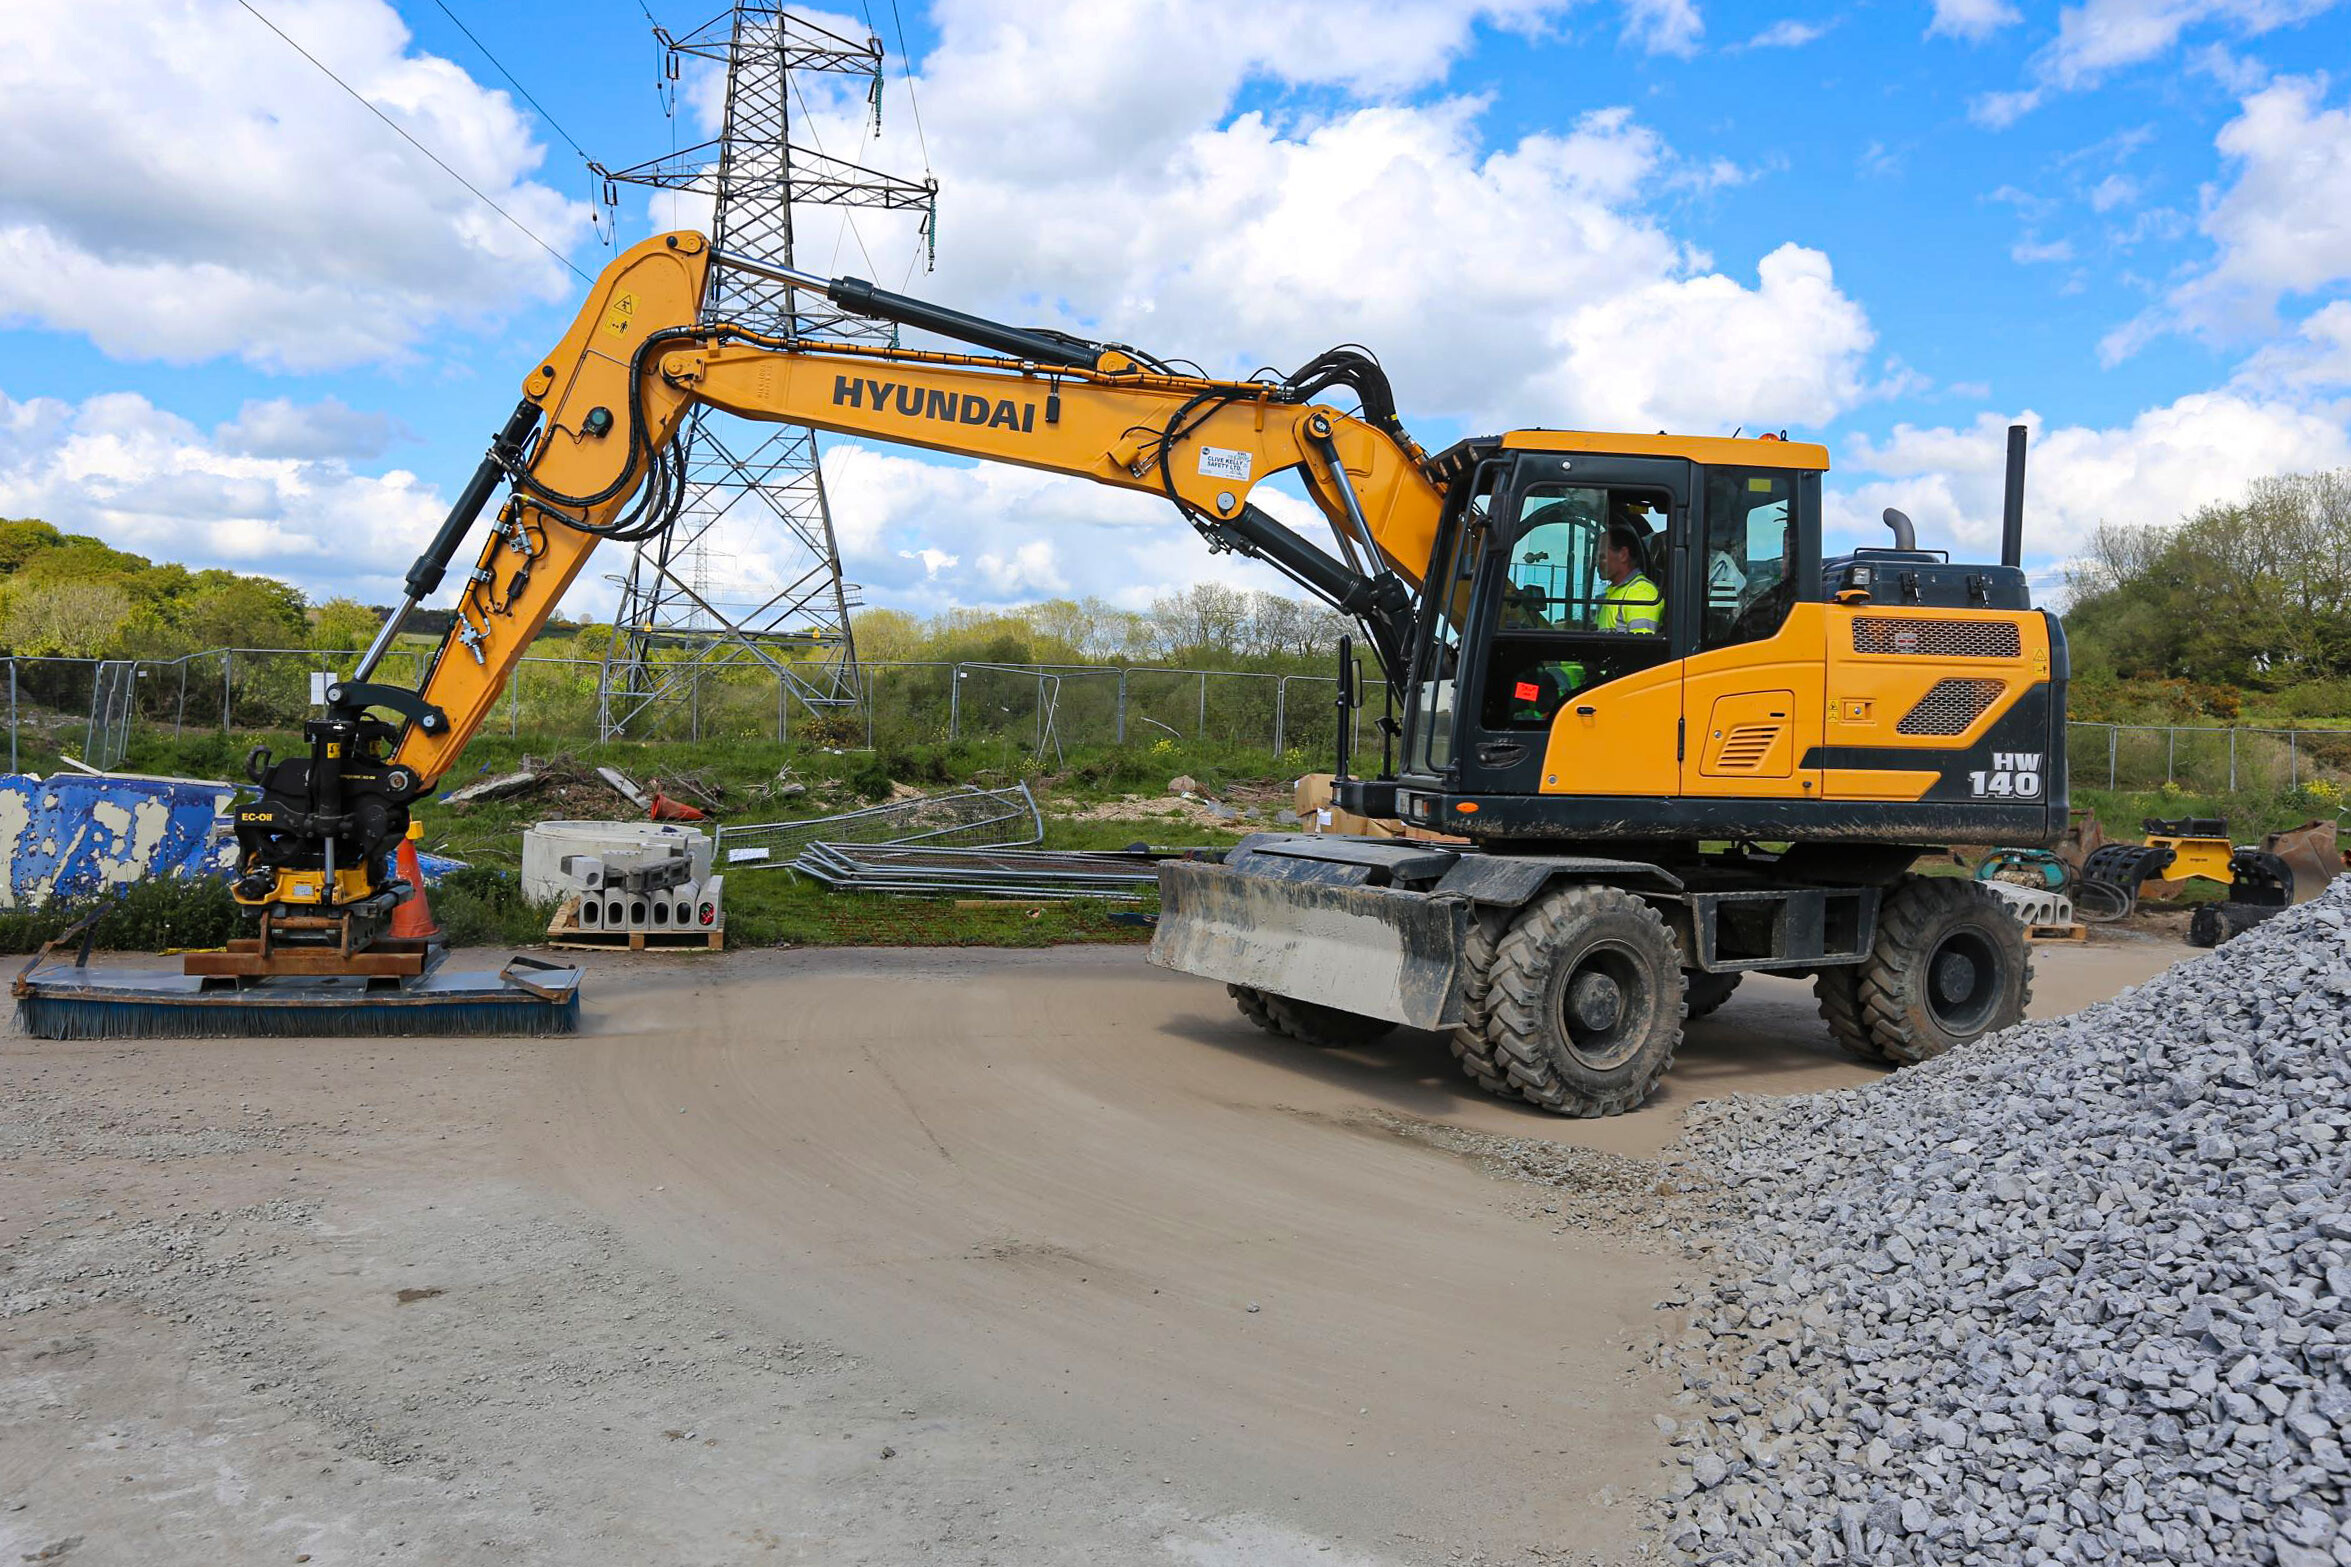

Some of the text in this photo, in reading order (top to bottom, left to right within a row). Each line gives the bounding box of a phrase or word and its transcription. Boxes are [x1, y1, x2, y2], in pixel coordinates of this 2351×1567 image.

[832, 375, 1035, 433] HYUNDAI
[1992, 752, 2041, 771] HW
[1969, 771, 2040, 797] 140
[241, 812, 273, 821] EC-Oil
